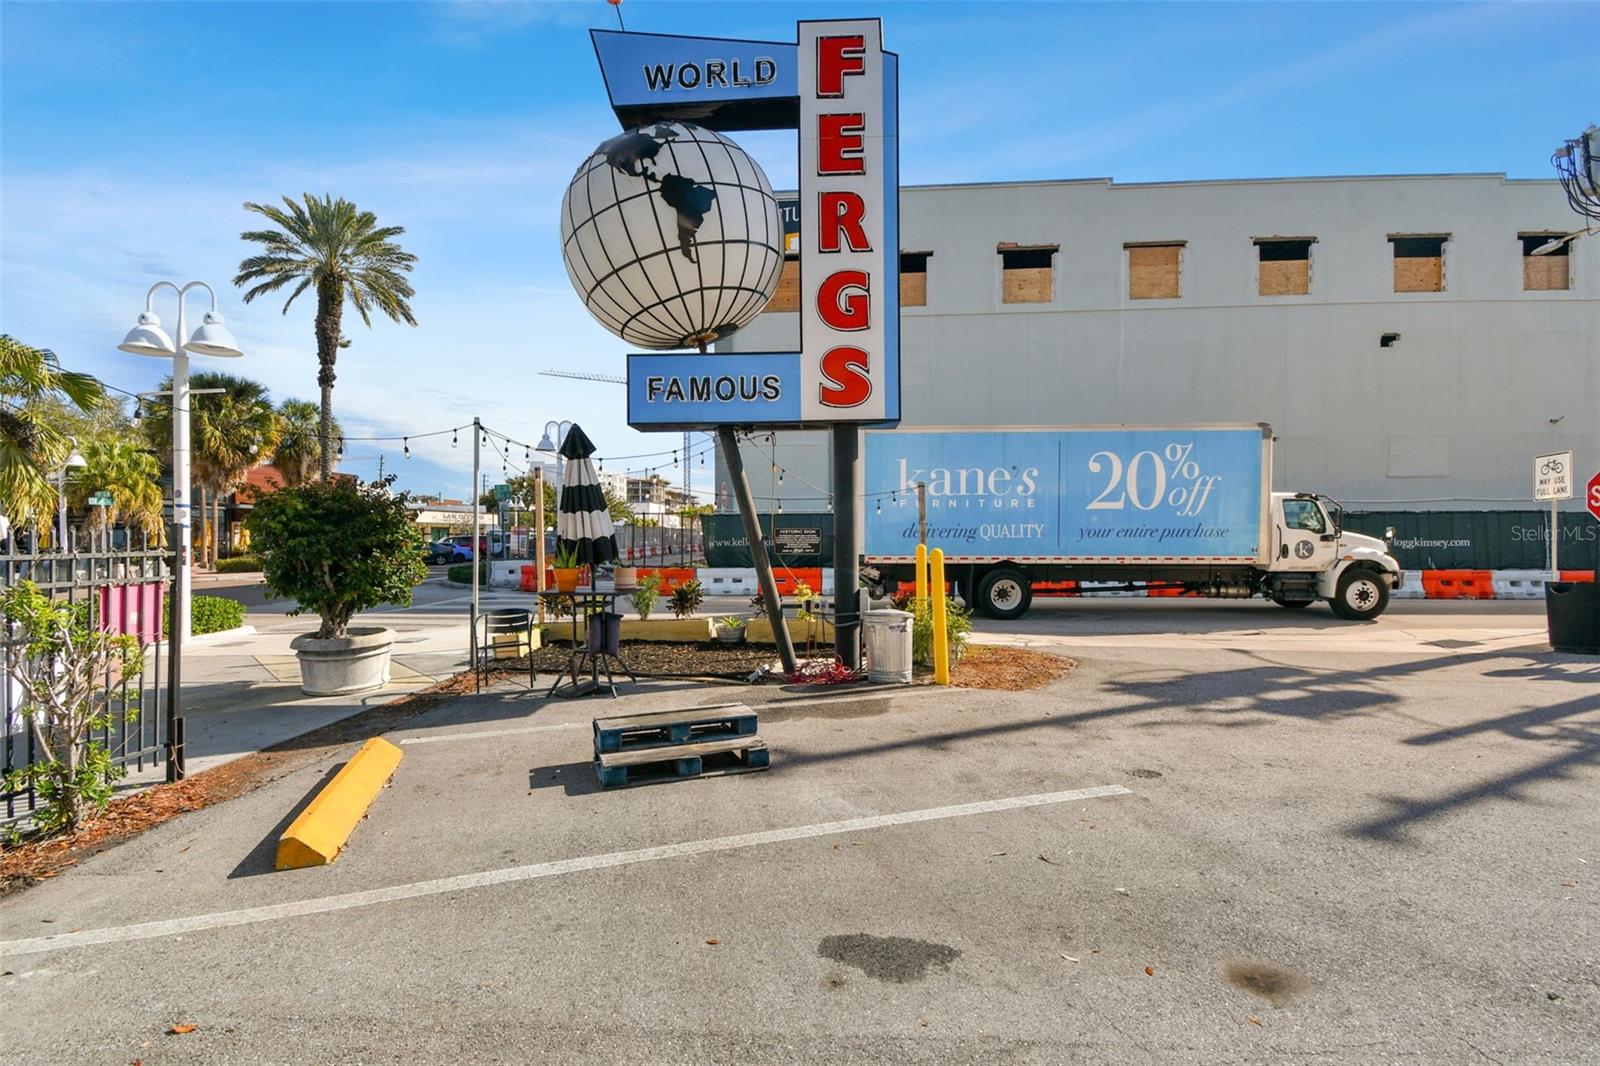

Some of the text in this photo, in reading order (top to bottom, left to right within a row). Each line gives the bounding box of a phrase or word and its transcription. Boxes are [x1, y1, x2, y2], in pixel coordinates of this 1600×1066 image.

[643, 56, 777, 91] WORLD
[816, 35, 873, 408] FERGS
[647, 374, 781, 402] FAMOUS
[896, 458, 1039, 496] kane's
[1086, 443, 1222, 516] 20% off
[1553, 486, 1568, 494] LANE
[1554, 475, 1565, 484] USE
[902, 522, 1045, 543] deivering QUALITY
[1076, 523, 1230, 543] your entire purchase
